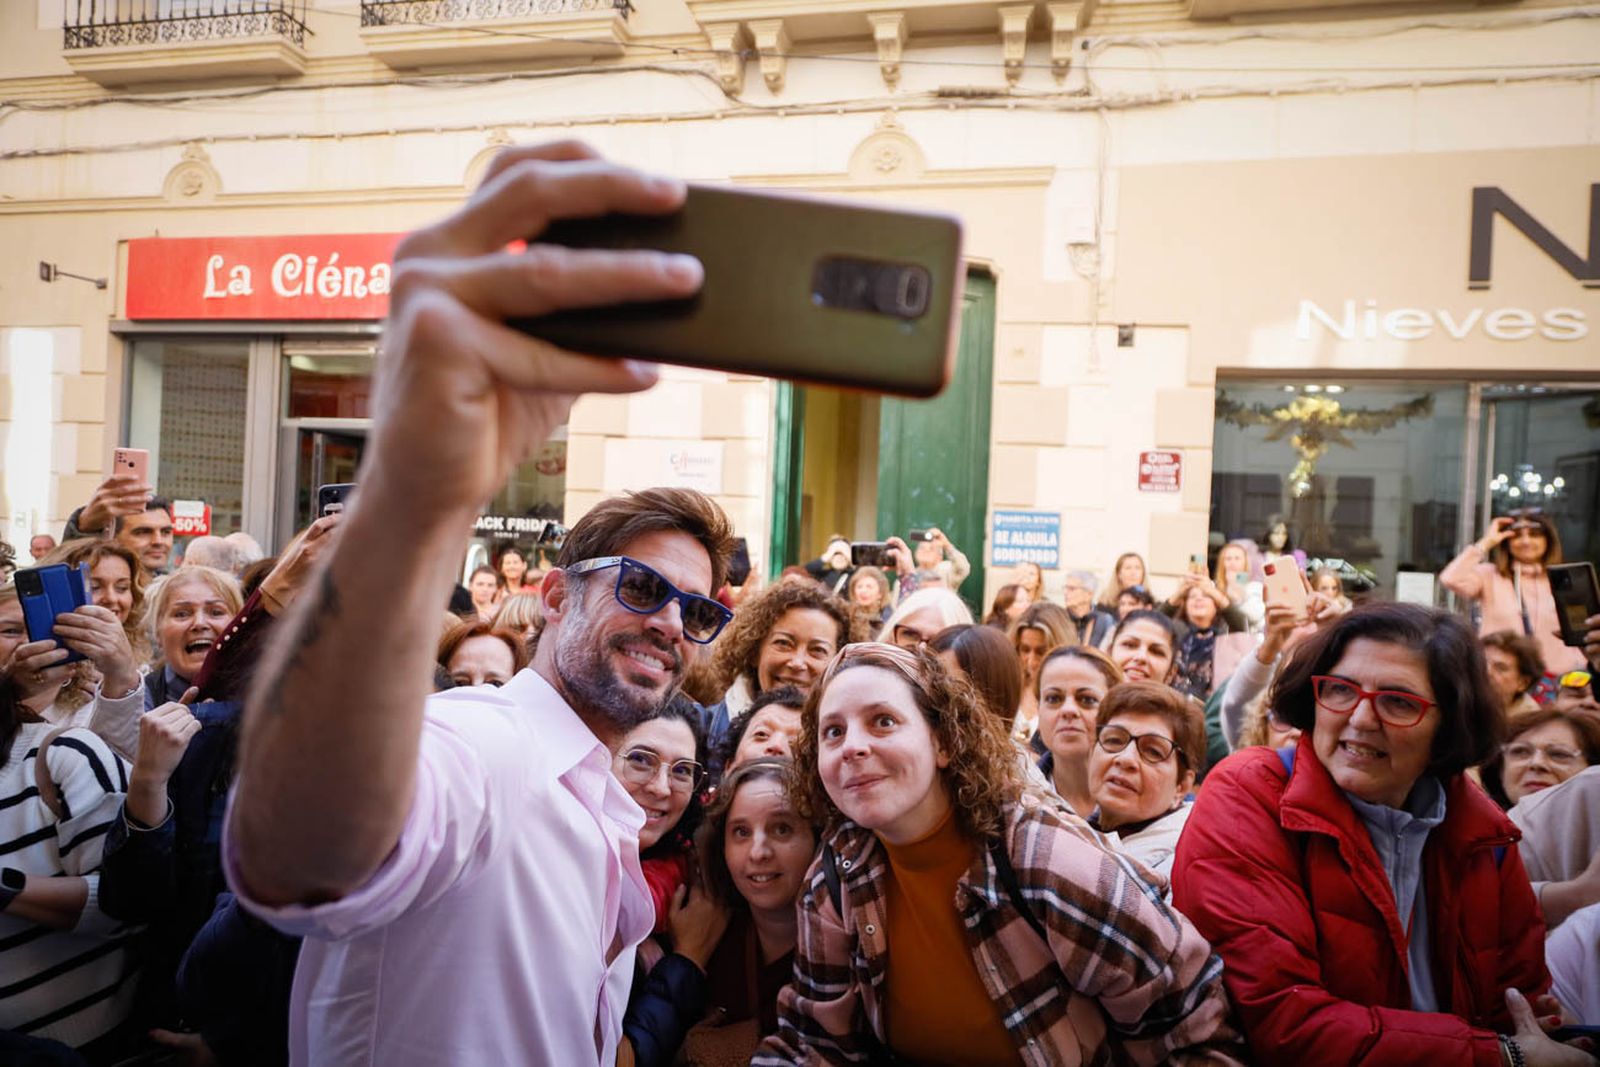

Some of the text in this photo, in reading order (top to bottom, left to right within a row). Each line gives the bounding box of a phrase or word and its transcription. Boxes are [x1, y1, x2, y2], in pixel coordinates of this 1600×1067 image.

[1468, 183, 1600, 290] N
[203, 252, 391, 299] La Ciéna
[1297, 299, 1589, 341] Nieves
[471, 516, 559, 532] ACK FRIDA
[1011, 531, 1057, 547] ALQUILA
